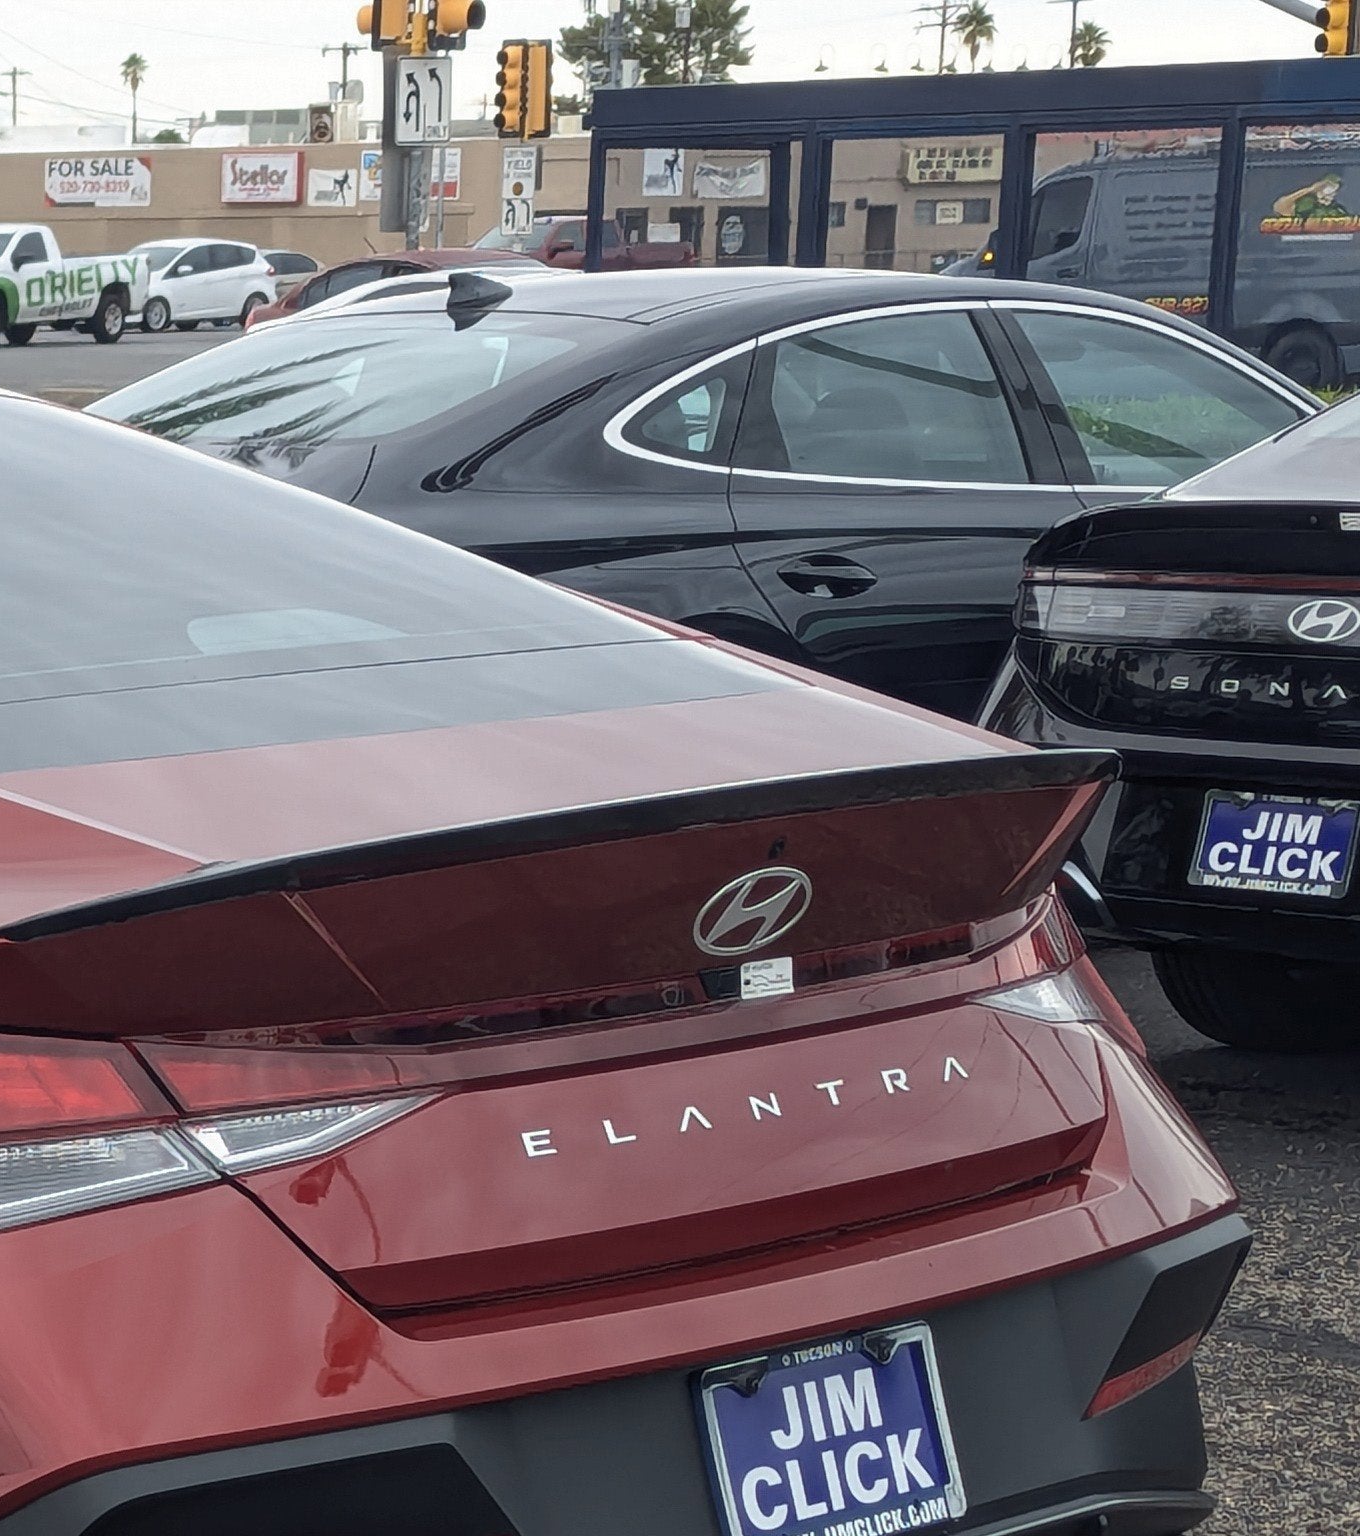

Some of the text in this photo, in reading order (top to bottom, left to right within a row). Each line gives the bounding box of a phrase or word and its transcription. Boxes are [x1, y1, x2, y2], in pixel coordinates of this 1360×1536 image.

[48, 158, 134, 177] FOR SALE
[230, 158, 288, 186] Stellar
[1242, 811, 1323, 846] JIM
[1208, 841, 1341, 882] CLICK
[520, 1056, 969, 1158] ELANTRA
[792, 1342, 844, 1365] TUCSON
[770, 1366, 883, 1450] JIM
[741, 1427, 935, 1531] CLICK
